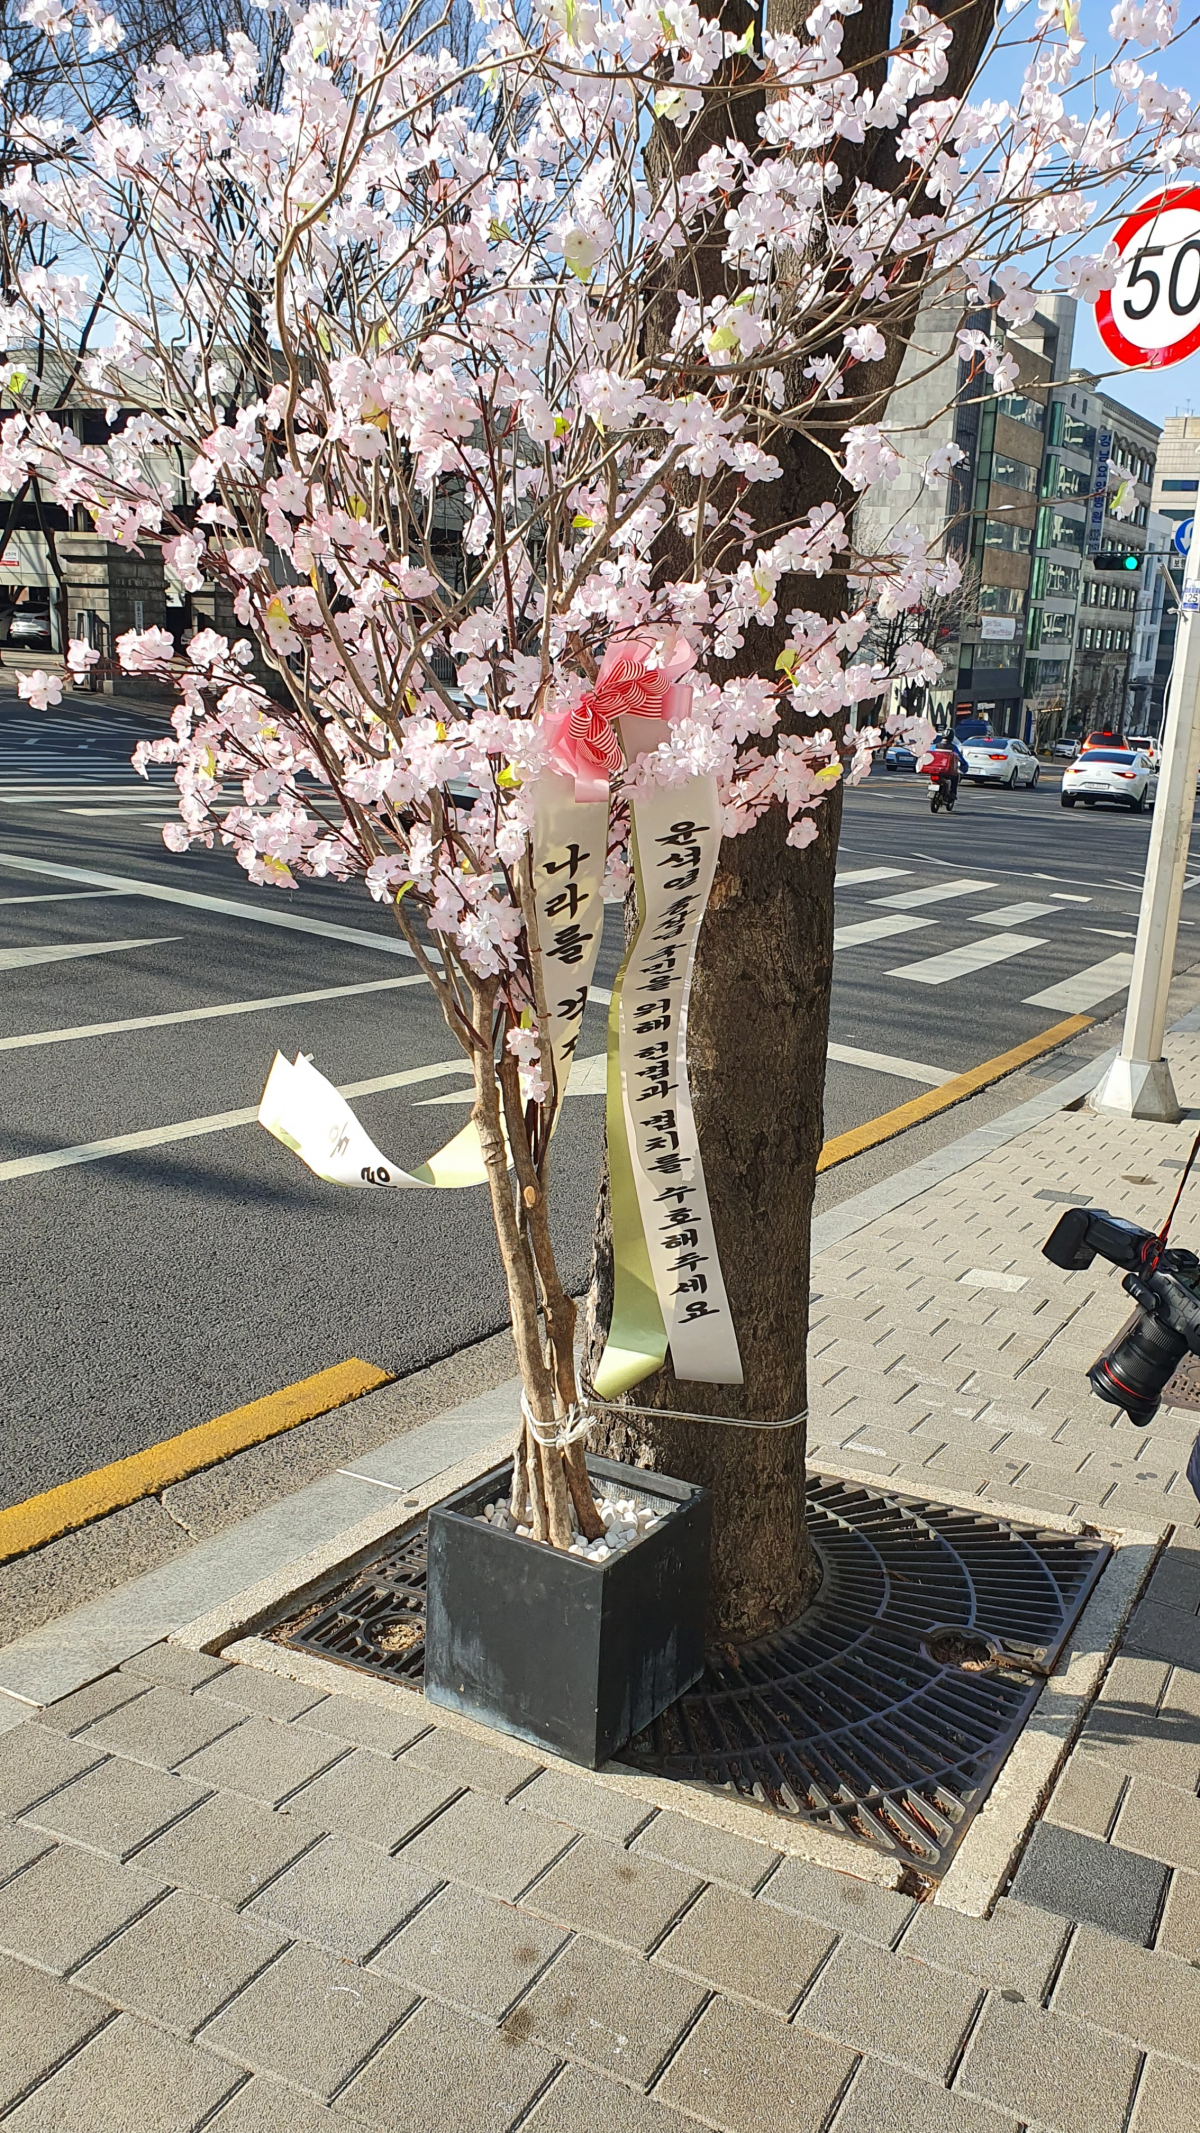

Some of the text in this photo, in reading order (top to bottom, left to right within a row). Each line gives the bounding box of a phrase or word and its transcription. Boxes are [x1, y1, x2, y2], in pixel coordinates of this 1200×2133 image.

[1123, 239, 1200, 321] 50
[655, 821, 710, 890] 윤석열
[542, 843, 592, 965] 나라를
[633, 998, 671, 1034] 위해
[633, 1041, 679, 1102] 헌법과
[640, 1109, 691, 1174] 법치를
